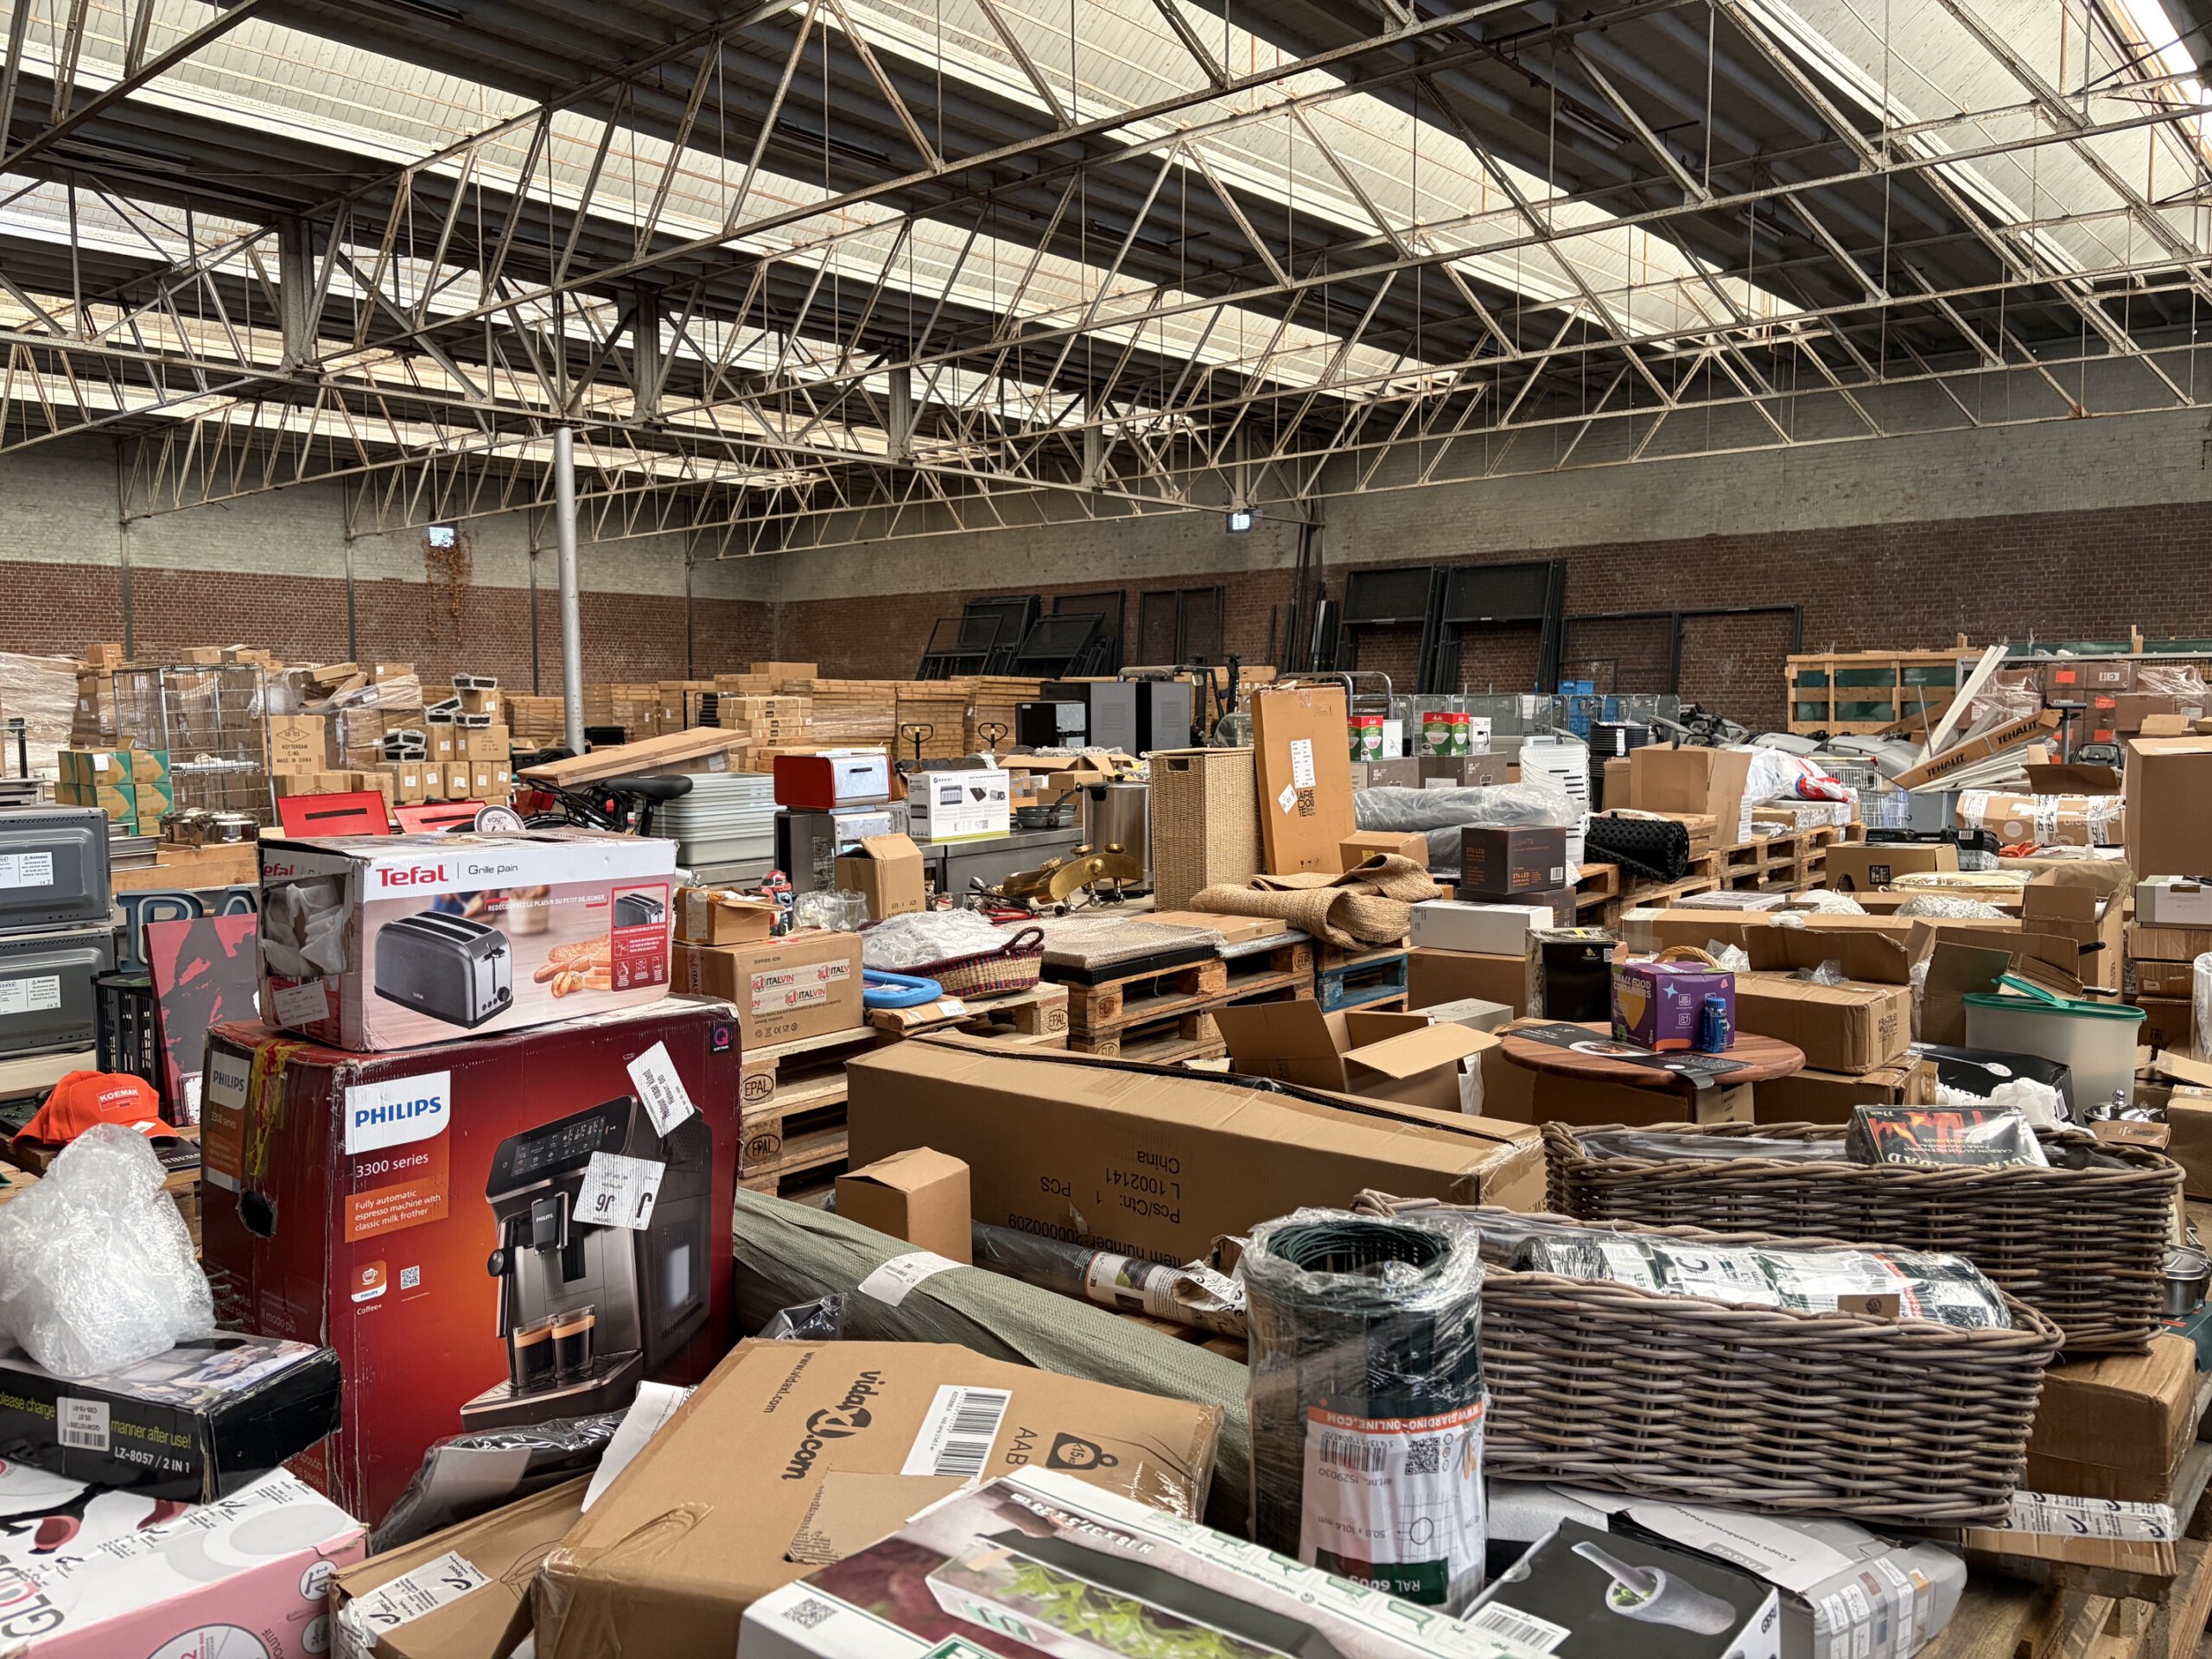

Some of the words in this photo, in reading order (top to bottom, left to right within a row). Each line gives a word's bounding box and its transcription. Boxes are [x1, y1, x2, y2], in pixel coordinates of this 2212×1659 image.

[1997, 721, 2037, 745] TEHALIT
[1926, 753, 1964, 777] TEHALIT
[264, 863, 295, 876] efal
[376, 864, 448, 887] Tefal
[468, 865, 494, 874] Grille
[579, 894, 605, 903] DÉJEUNER
[830, 964, 849, 974] ITALV
[766, 974, 794, 986] ITALVIN
[1613, 973, 1630, 985] SMALL
[1632, 977, 1651, 989] FOOD
[798, 988, 825, 999] ITALVIN
[1613, 982, 1651, 999] CONTAINERS
[1049, 1014, 1066, 1027] EPAL
[213, 1070, 245, 1092] PHILIPS
[745, 1079, 770, 1096] EPAL
[99, 1088, 138, 1103] KOEMAN
[651, 1084, 663, 1099] naar
[354, 1096, 442, 1128] PHILIPS
[752, 1138, 774, 1156] EPAL
[355, 1160, 389, 1179] 3300
[392, 1154, 429, 1171] series
[1137, 1151, 1180, 1174] China
[1039, 1176, 1071, 1198] PCS
[1105, 1167, 1166, 1196] 1002141
[1096, 1191, 1102, 1205] 1
[1171, 1182, 1180, 1200] L
[354, 1206, 389, 1223] espresso
[390, 1199, 423, 1215] machine
[423, 1193, 442, 1208] with
[355, 1196, 373, 1211] Fully
[375, 1190, 416, 1207] automatic
[1119, 1194, 1180, 1224] Pcs/Ctn:
[355, 1216, 379, 1231] classic
[381, 1211, 399, 1225] milk
[400, 1206, 429, 1221] frother
[536, 1211, 554, 1223] PHILIPS
[360, 1289, 378, 1300] PHILIPS
[357, 1303, 382, 1315] Coffee+
[762, 1351, 815, 1414] www.vidaxl.com
[26, 1398, 55, 1420] charge
[111, 1418, 145, 1440] manner
[147, 1426, 168, 1445] after
[170, 1431, 191, 1450] use!
[1005, 1427, 1039, 1465] AAB
[114, 1446, 155, 1465] LZ-8057
[155, 1454, 162, 1468] /
[162, 1456, 170, 1468] 2
[171, 1459, 182, 1471] IN
[184, 1461, 190, 1473] 1
[1319, 1467, 1359, 1484] 1529030
[1669, 1505, 1704, 1523] Holder
[1705, 1521, 1761, 1548] Toothbrush
[1764, 1546, 1788, 1560] Cups
[1395, 1580, 1421, 1592] RAL
